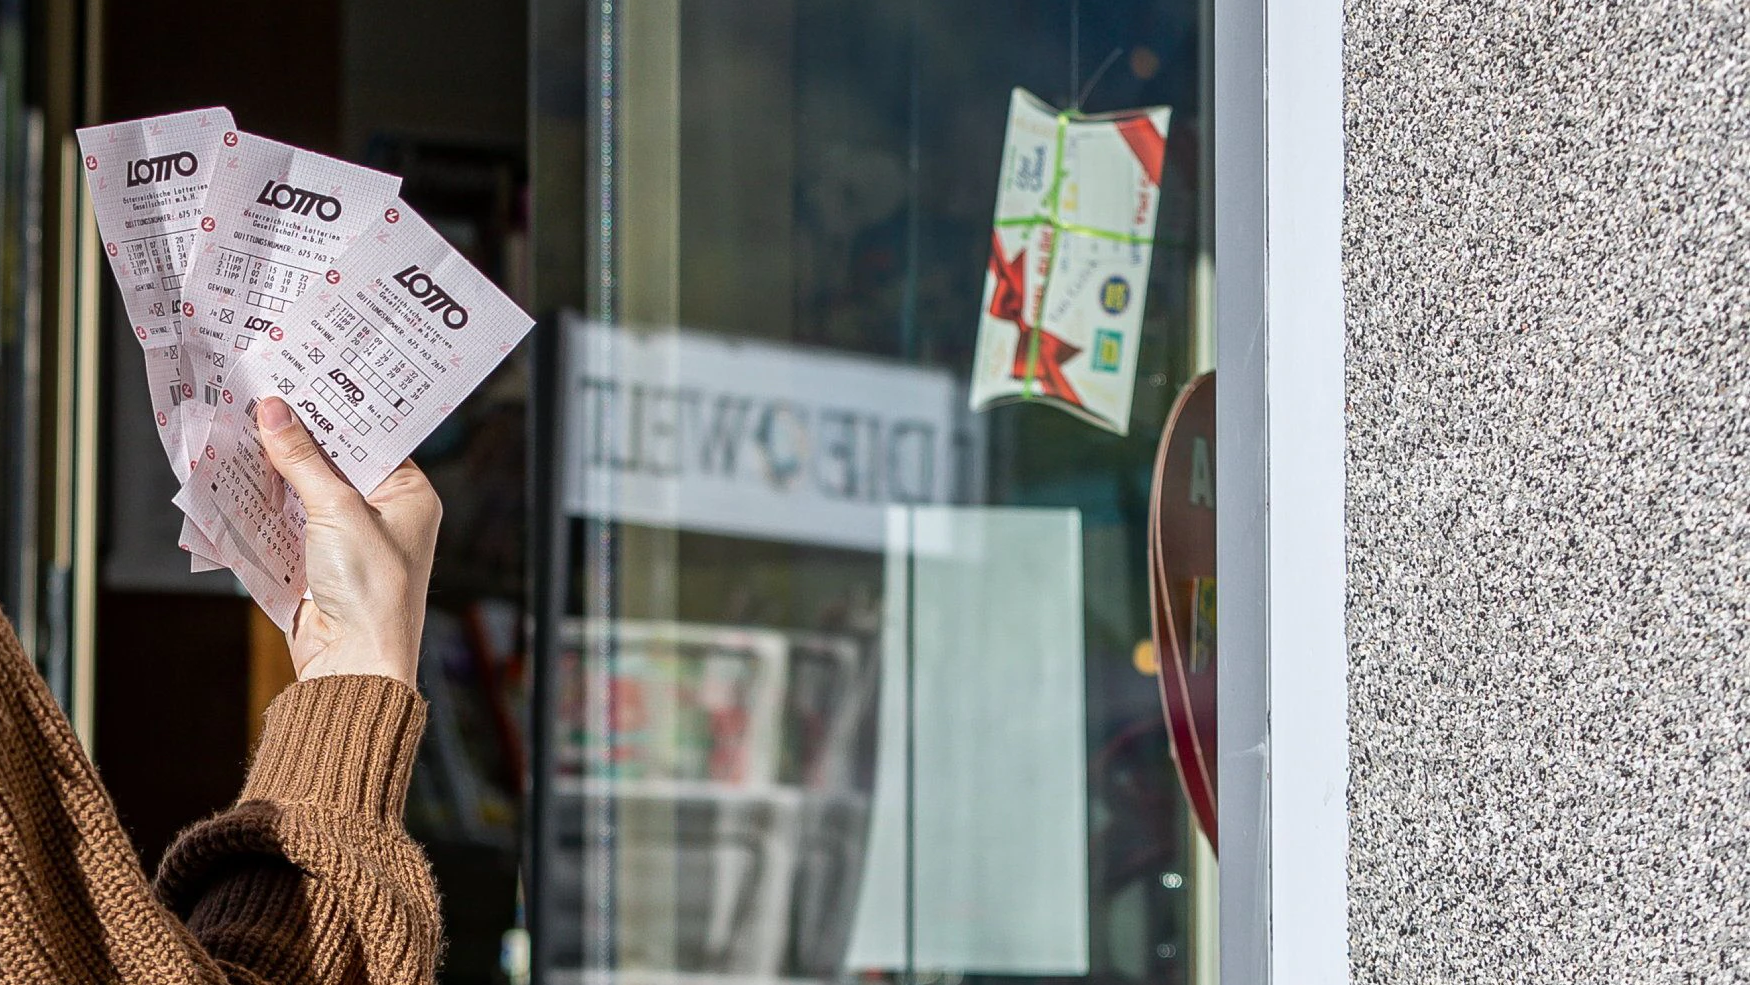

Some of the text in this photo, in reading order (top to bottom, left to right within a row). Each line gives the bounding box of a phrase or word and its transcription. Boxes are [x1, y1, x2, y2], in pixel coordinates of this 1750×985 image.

[127, 151, 198, 188] LOTTO
[174, 184, 208, 195] Lotterien
[256, 180, 342, 222] LOTTO
[132, 198, 172, 211] Gesellschaft
[178, 210, 191, 219] 675
[193, 207, 204, 216] 76
[252, 220, 299, 238] Gesellschaft
[305, 225, 341, 241] Lotterien
[220, 253, 244, 264] 1.TIPP
[254, 262, 262, 270] 12
[269, 266, 277, 274] 15
[300, 274, 309, 282] 22
[298, 249, 311, 259] 675
[314, 252, 327, 262] 763
[215, 269, 239, 279] 3.TIPP
[218, 261, 241, 272] 2.TIPP
[297, 282, 307, 290] 23
[378, 291, 417, 327] Gesellschaft
[392, 264, 468, 329] LOTTO
[243, 315, 274, 333] LOT
[423, 321, 453, 349] Lotterien
[324, 313, 420, 401] 3.TIPP 20 24 27 29 33 39
[329, 307, 351, 326] 2.TIPP
[369, 343, 378, 351] 11
[380, 354, 390, 363] 29
[392, 365, 401, 374] 30
[403, 376, 413, 385] 39
[416, 387, 425, 396] 41
[335, 302, 356, 321] 1.TIPP
[374, 337, 383, 346] 09
[386, 349, 395, 357] 11
[397, 359, 407, 369] 16
[409, 370, 419, 380] 32
[421, 381, 431, 390] 38
[407, 339, 419, 350] 675
[419, 349, 432, 361] 763
[431, 359, 447, 374] 2679
[327, 368, 365, 402] LOTTO
[367, 404, 382, 419] Nein
[344, 393, 360, 408] PLUS
[297, 399, 335, 434] JOKER
[338, 434, 352, 449] Nein
